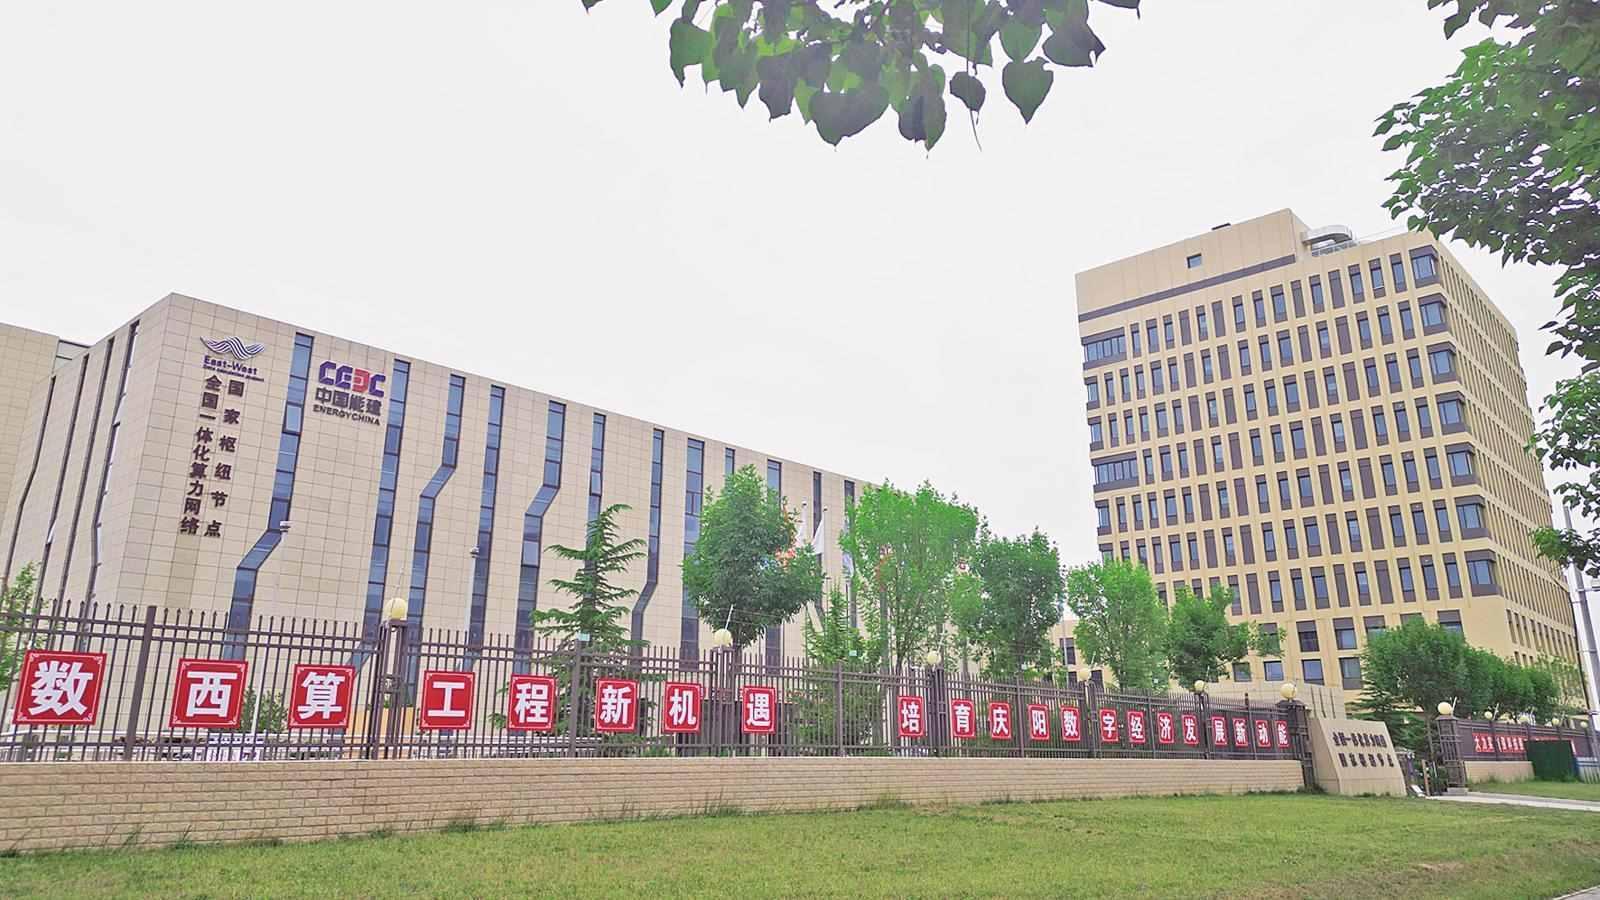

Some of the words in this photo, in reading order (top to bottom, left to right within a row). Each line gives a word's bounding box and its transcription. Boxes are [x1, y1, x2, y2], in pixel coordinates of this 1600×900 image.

[204, 355, 258, 375] East-West
[315, 387, 382, 417] 中国能建
[180, 374, 223, 537] 全国一体化算力网络
[204, 379, 245, 538] 国家枢纽节点
